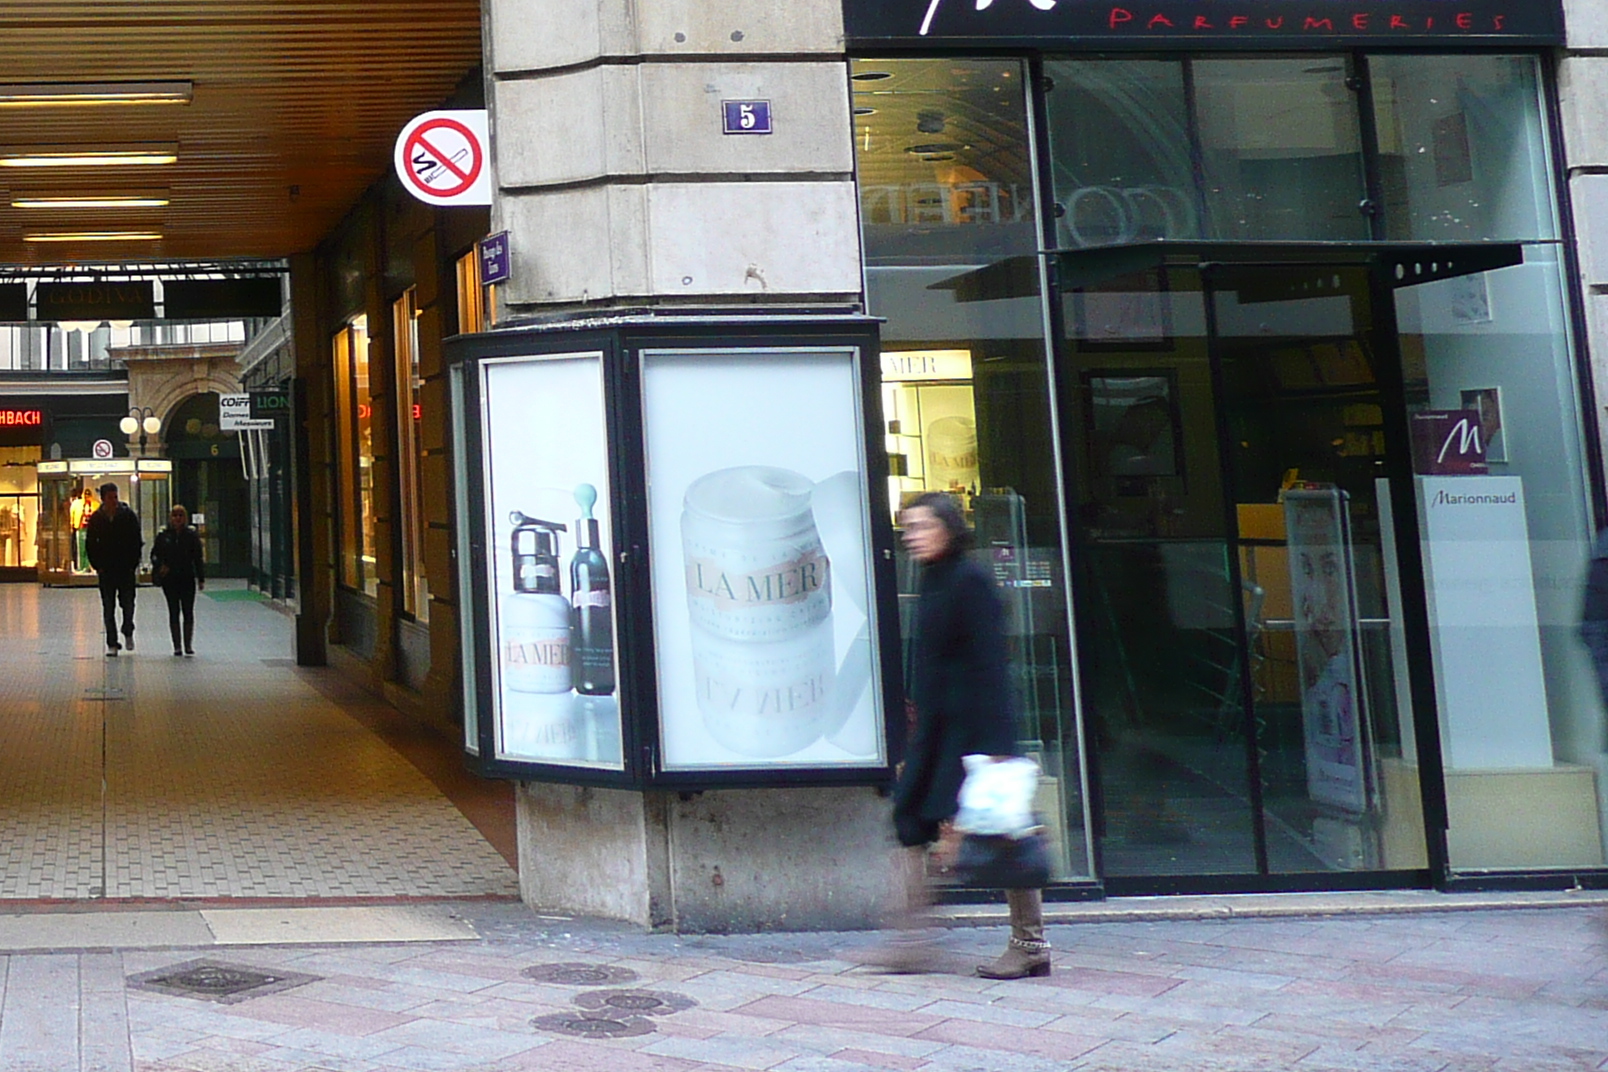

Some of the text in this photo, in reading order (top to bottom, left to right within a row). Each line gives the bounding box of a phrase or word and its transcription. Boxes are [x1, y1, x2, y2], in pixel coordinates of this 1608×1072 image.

[739, 104, 756, 129] 5
[49, 286, 146, 306] GODIVA
[1431, 490, 1517, 508] Marionnaud
[696, 561, 818, 603] LA MER
[506, 640, 529, 665] LA
